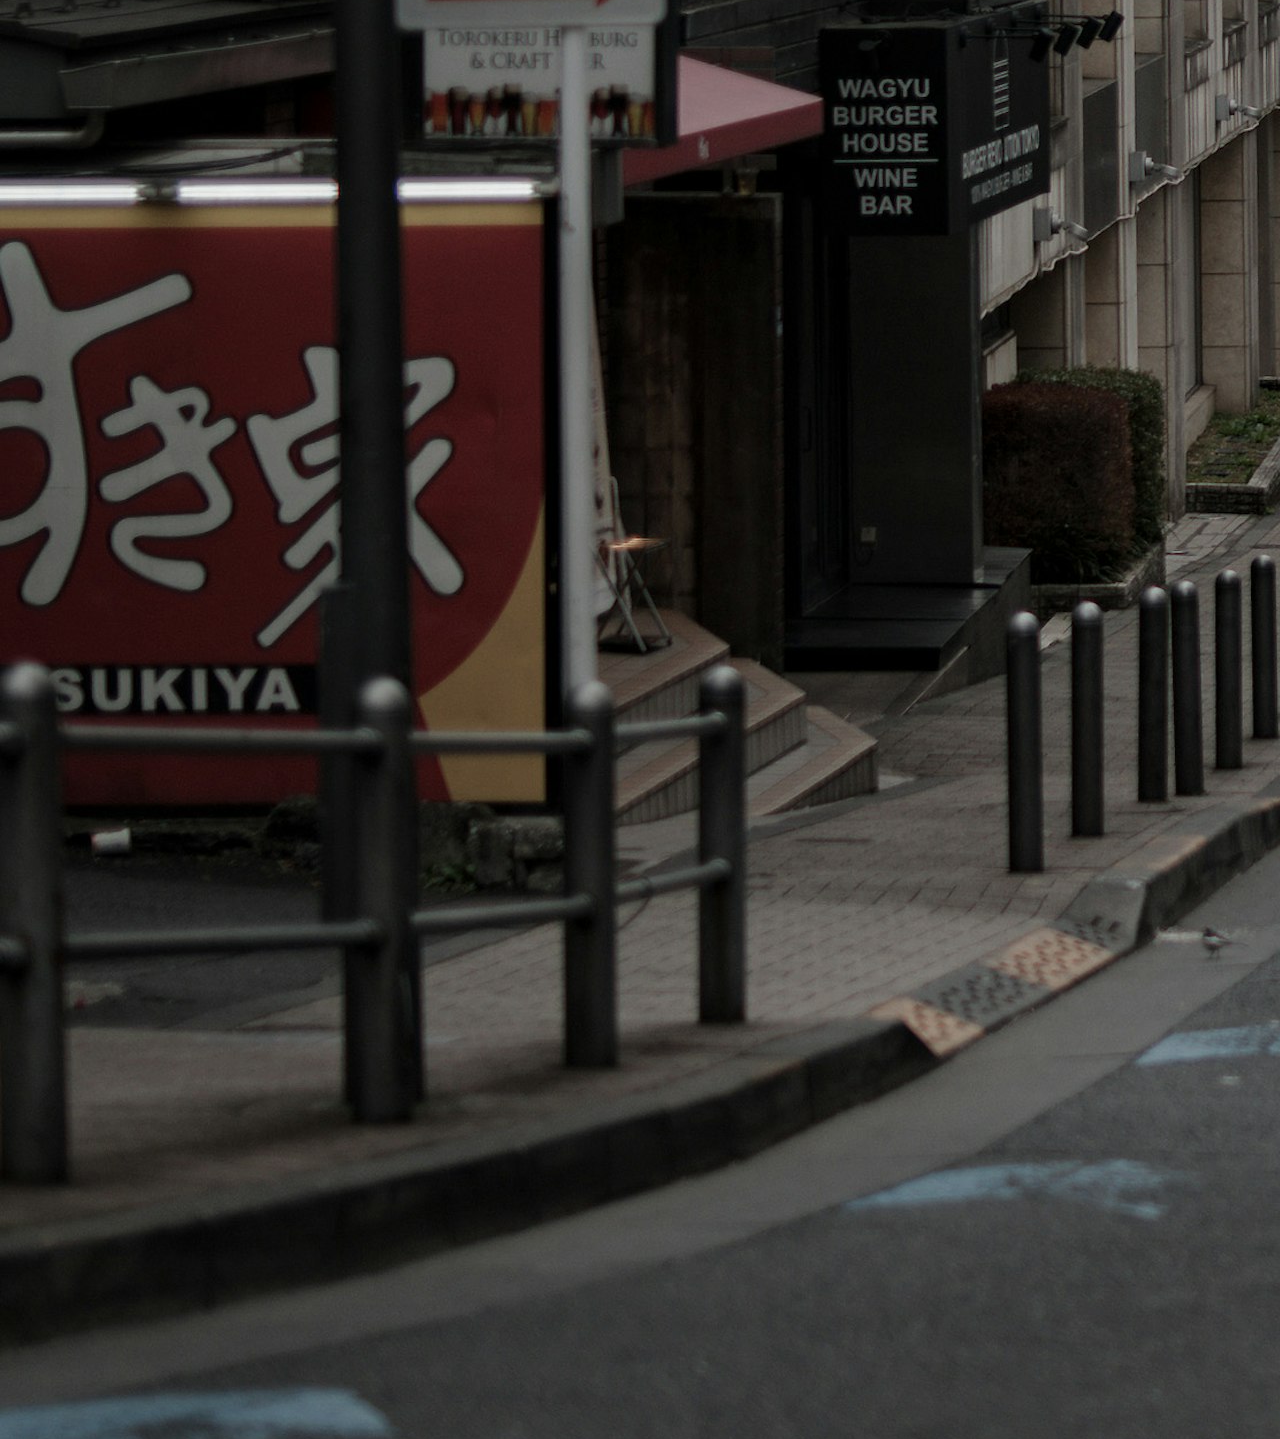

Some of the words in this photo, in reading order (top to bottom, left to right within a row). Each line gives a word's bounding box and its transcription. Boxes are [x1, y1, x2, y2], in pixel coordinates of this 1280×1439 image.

[491, 52, 552, 69] CRAFT
[837, 77, 931, 99] WAGYU
[832, 105, 939, 126] BURGER
[842, 132, 930, 154] HOUSE
[853, 167, 919, 189] WINE
[860, 194, 914, 216] BAR
[51, 666, 301, 713] SUKIYA
